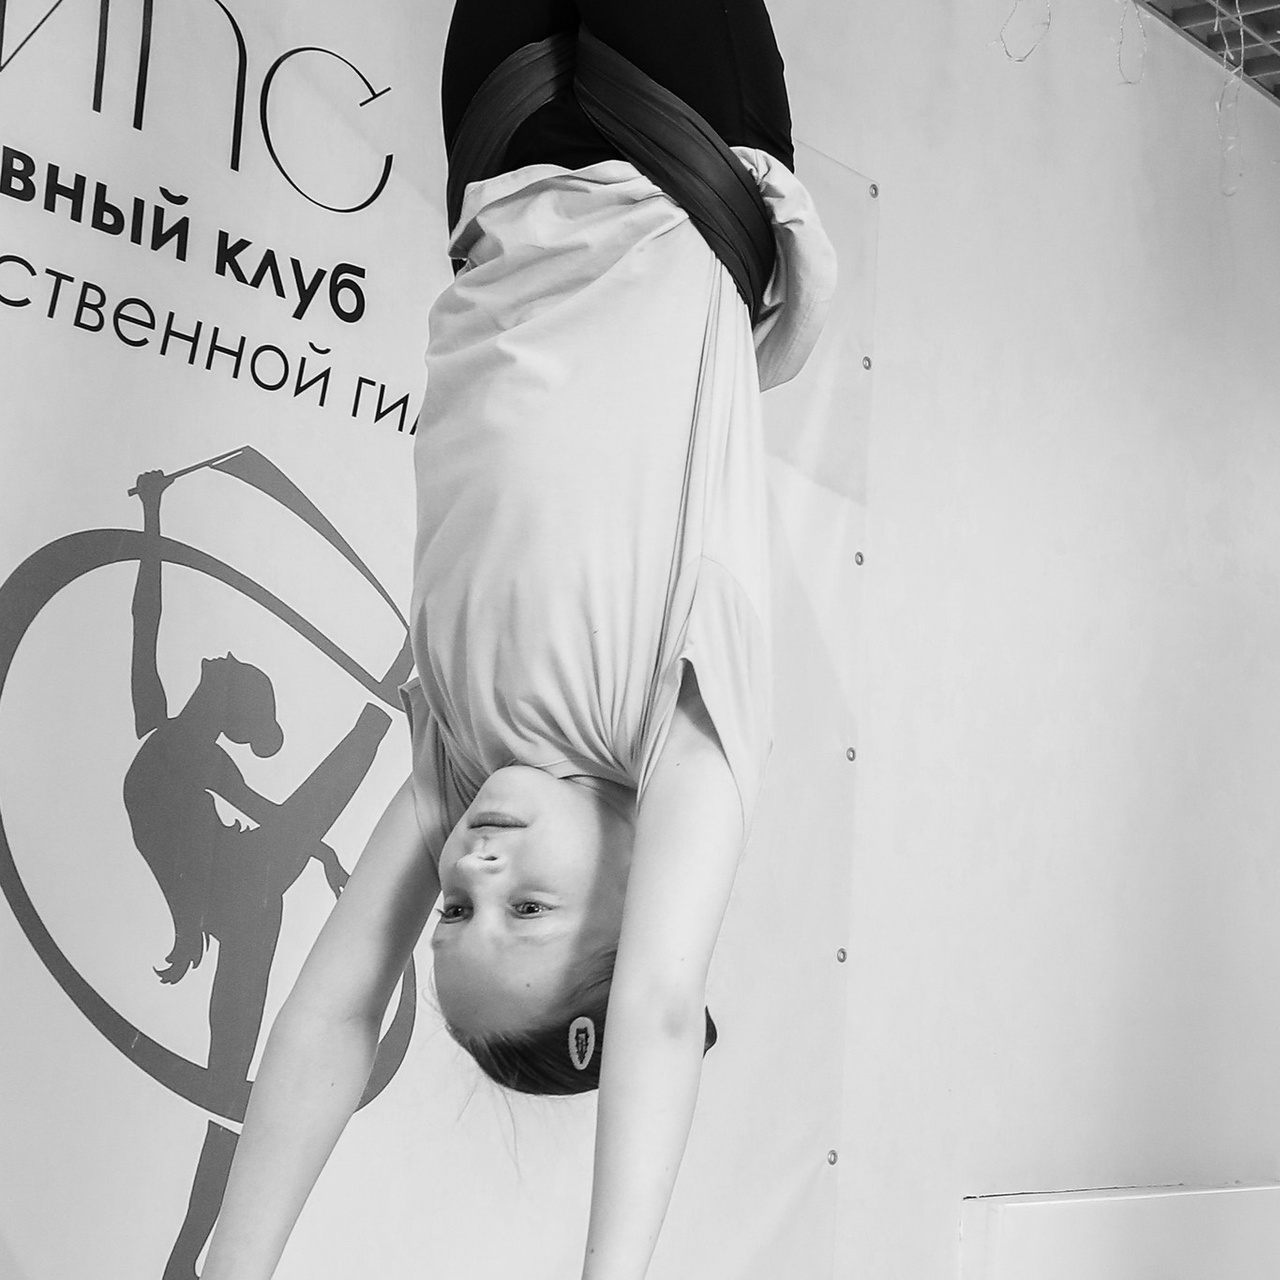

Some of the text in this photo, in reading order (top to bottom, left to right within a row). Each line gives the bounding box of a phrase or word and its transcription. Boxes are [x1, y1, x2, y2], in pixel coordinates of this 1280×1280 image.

[0, 145, 367, 324] вный клуб
[0, 254, 421, 436] ственной ги
